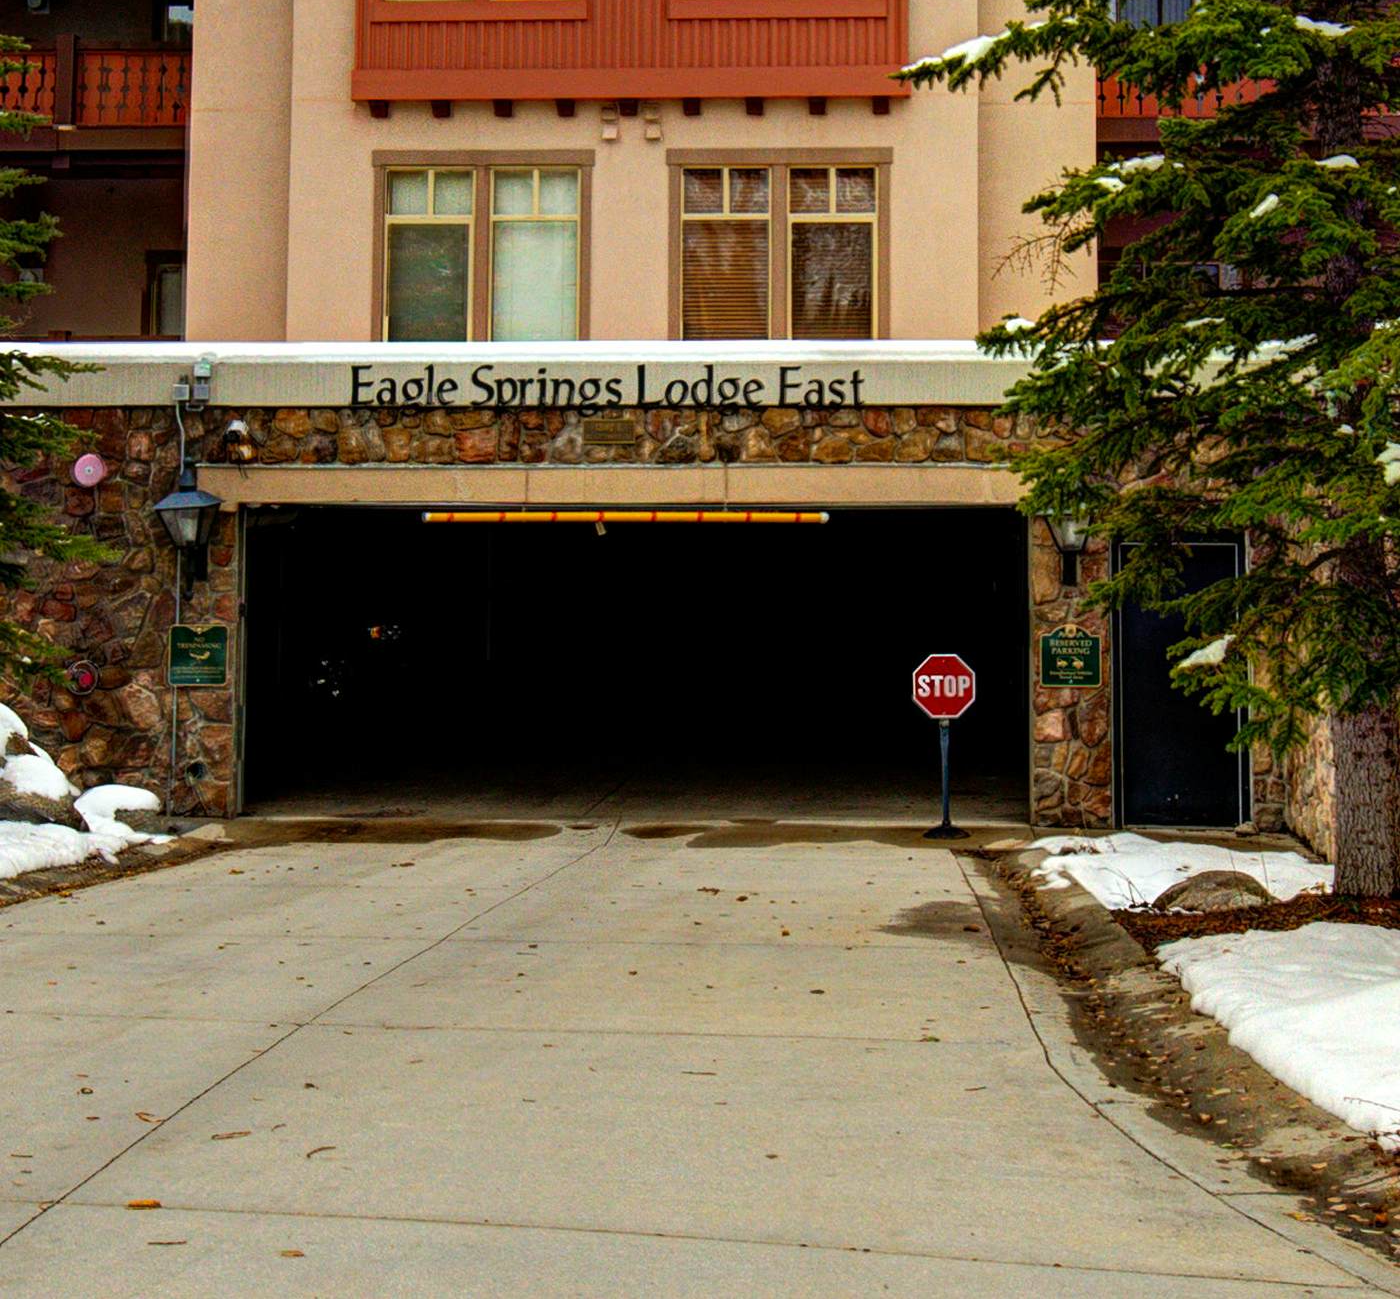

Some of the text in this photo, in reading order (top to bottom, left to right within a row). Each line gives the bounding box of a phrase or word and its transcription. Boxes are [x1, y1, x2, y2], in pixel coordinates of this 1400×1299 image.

[351, 364, 865, 417] Eagle Springs Lodge East
[1049, 639, 1093, 647] RESERVED
[1051, 647, 1090, 655] PARKING
[917, 674, 971, 698] STOP
